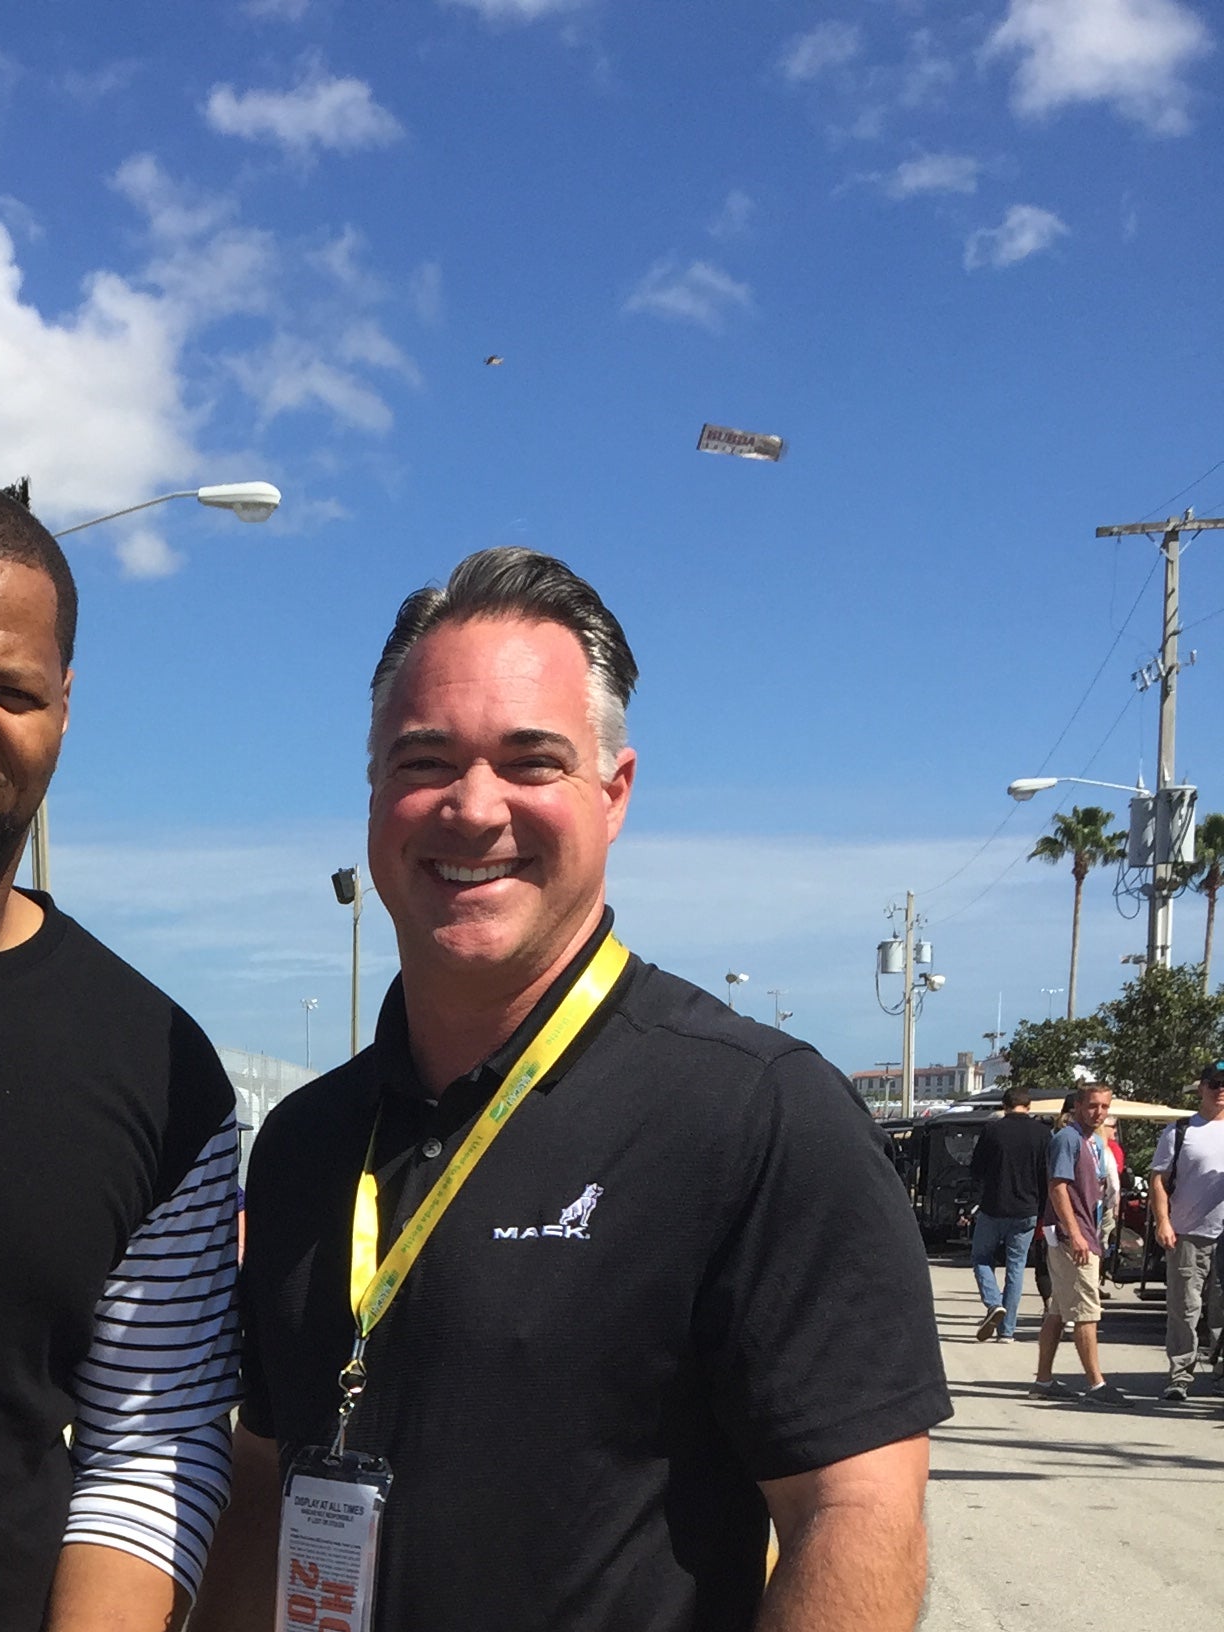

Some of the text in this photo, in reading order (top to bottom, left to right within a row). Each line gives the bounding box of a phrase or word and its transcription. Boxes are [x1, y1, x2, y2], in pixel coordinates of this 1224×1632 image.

[294, 1496, 365, 1517] DISPLAY AT ALL TIMES
